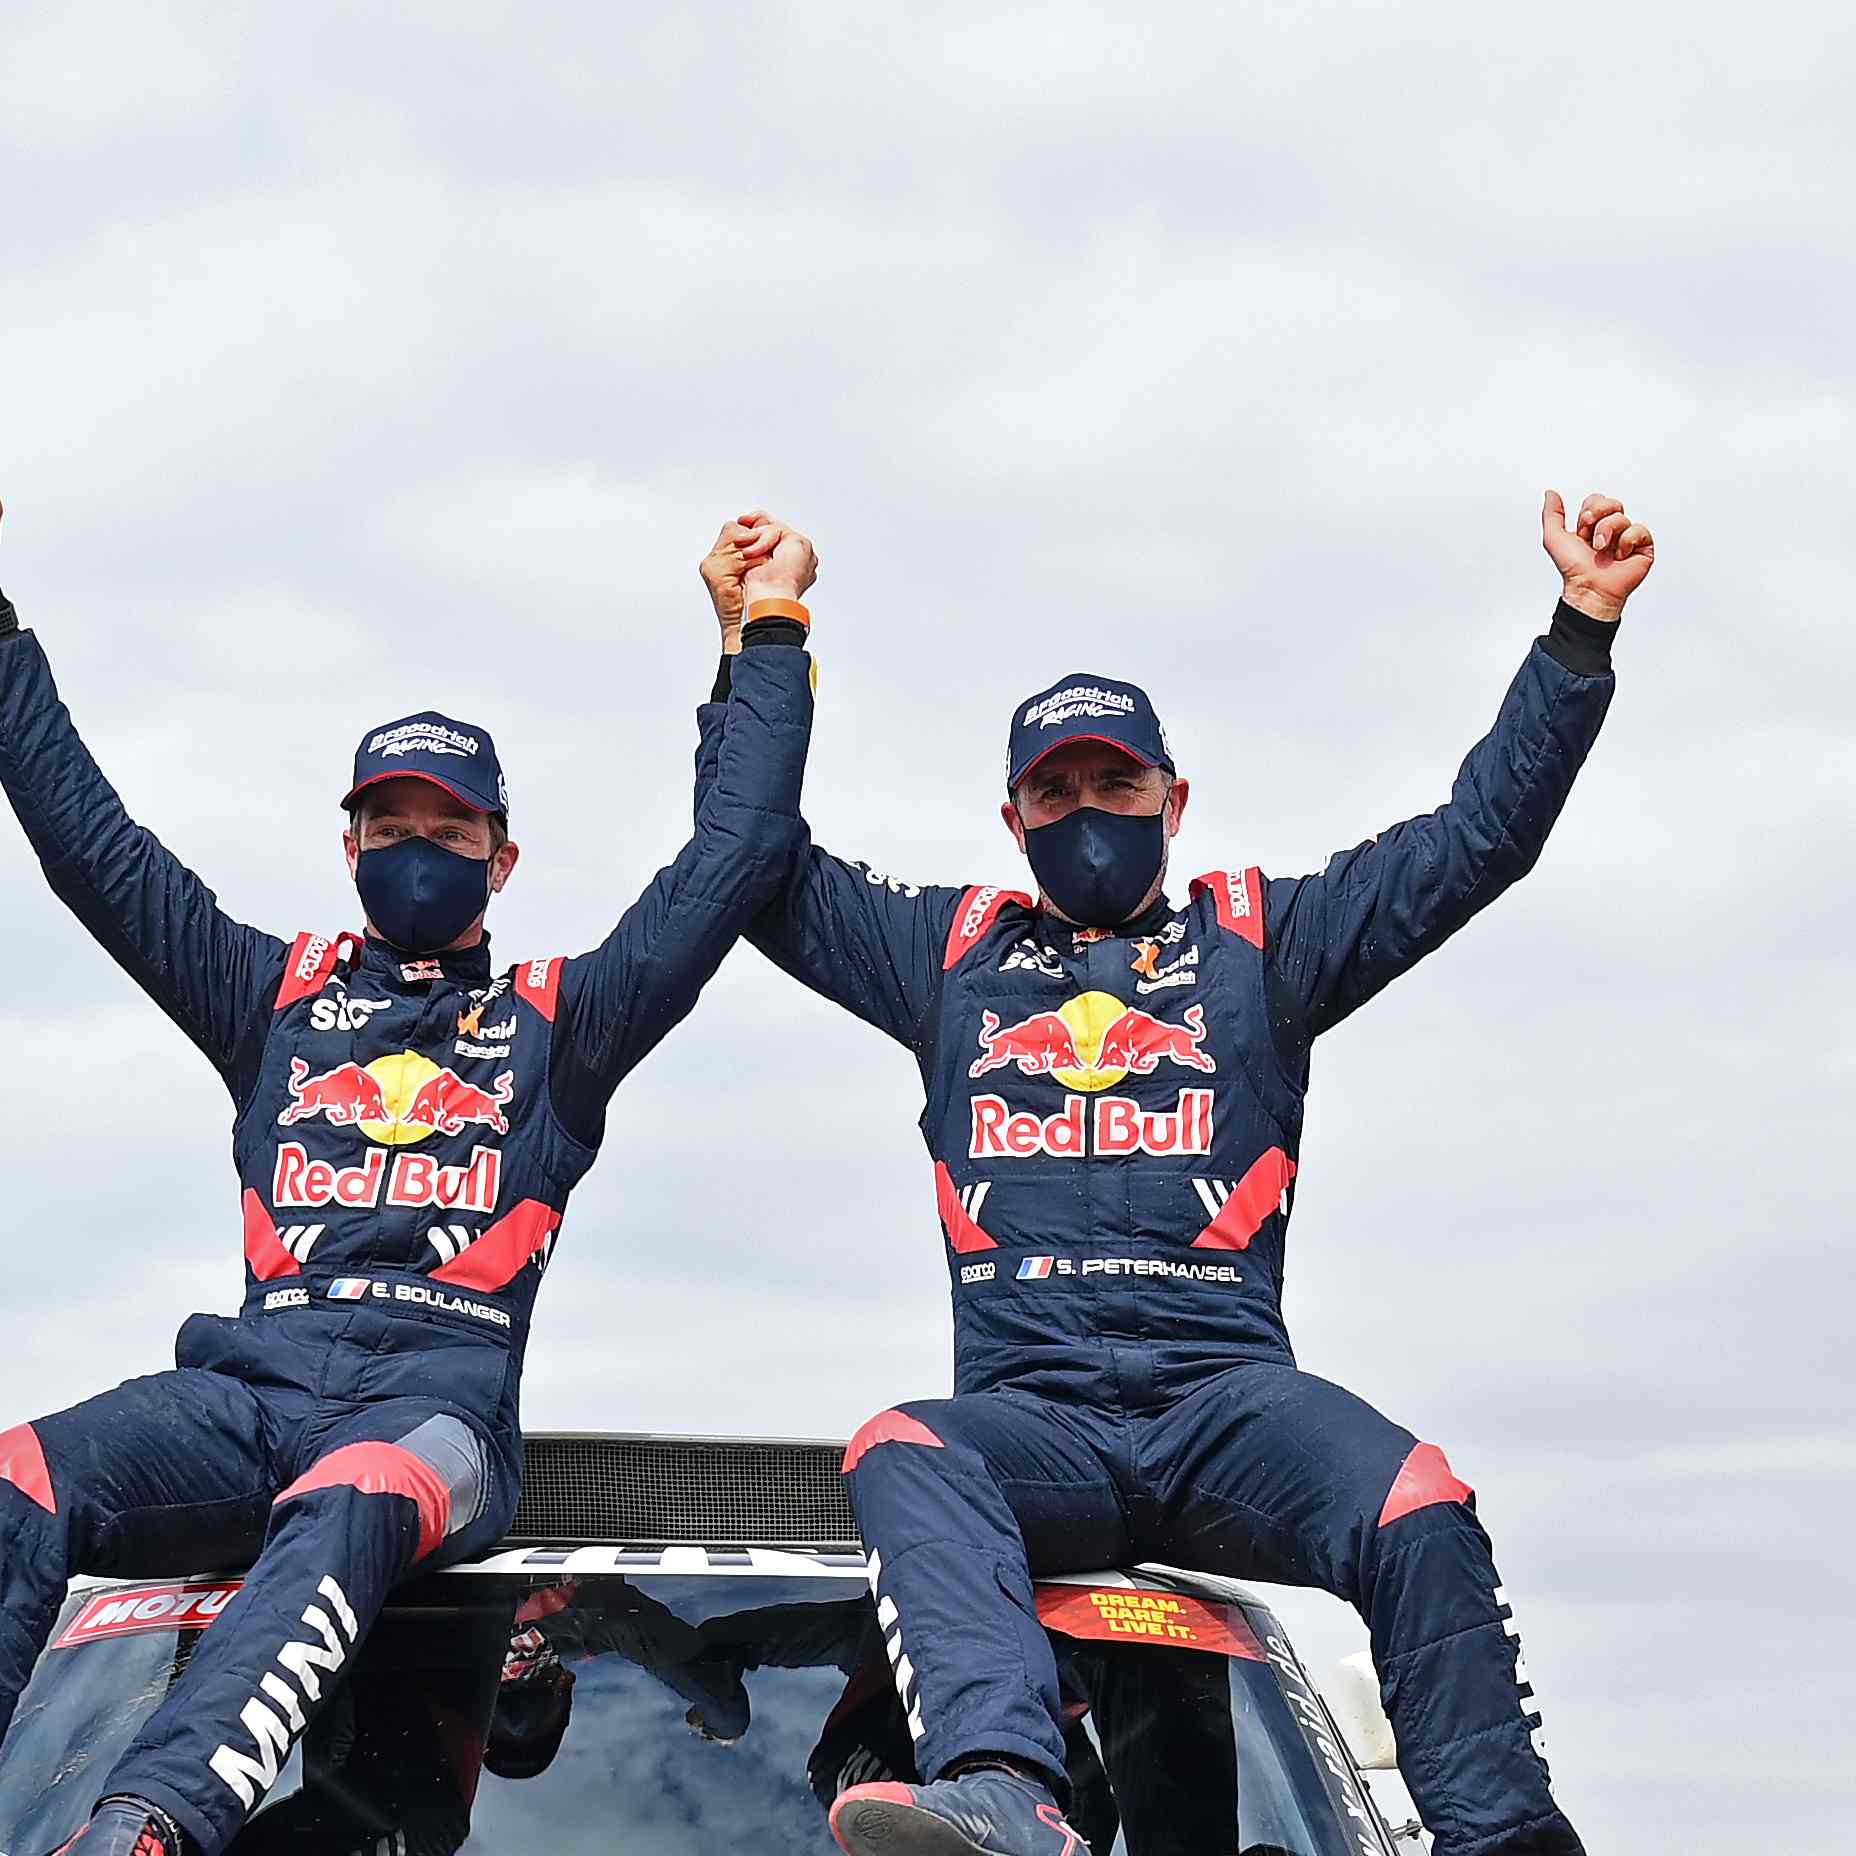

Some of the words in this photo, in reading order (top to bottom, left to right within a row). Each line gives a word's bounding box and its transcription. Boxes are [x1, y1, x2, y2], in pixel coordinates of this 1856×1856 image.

[1040, 702, 1125, 730] RACING
[381, 738, 468, 758] RACING
[969, 1092, 1086, 1158] Red
[1093, 1087, 1215, 1157] Bull
[272, 1140, 384, 1209] Red
[386, 1144, 502, 1214] Bull
[1057, 1259, 1077, 1275] S.
[1082, 1258, 1243, 1282] PETERHANSEL
[372, 1282, 391, 1298] E.
[395, 1284, 512, 1328] BOULANGER
[82, 1590, 240, 1630] MOTU
[1090, 1592, 1188, 1615] DREAM.
[1099, 1606, 1175, 1624] DARE.
[1108, 1619, 1164, 1636] LIVE
[1166, 1623, 1199, 1640] IT.
[209, 1575, 360, 1812] MINI
